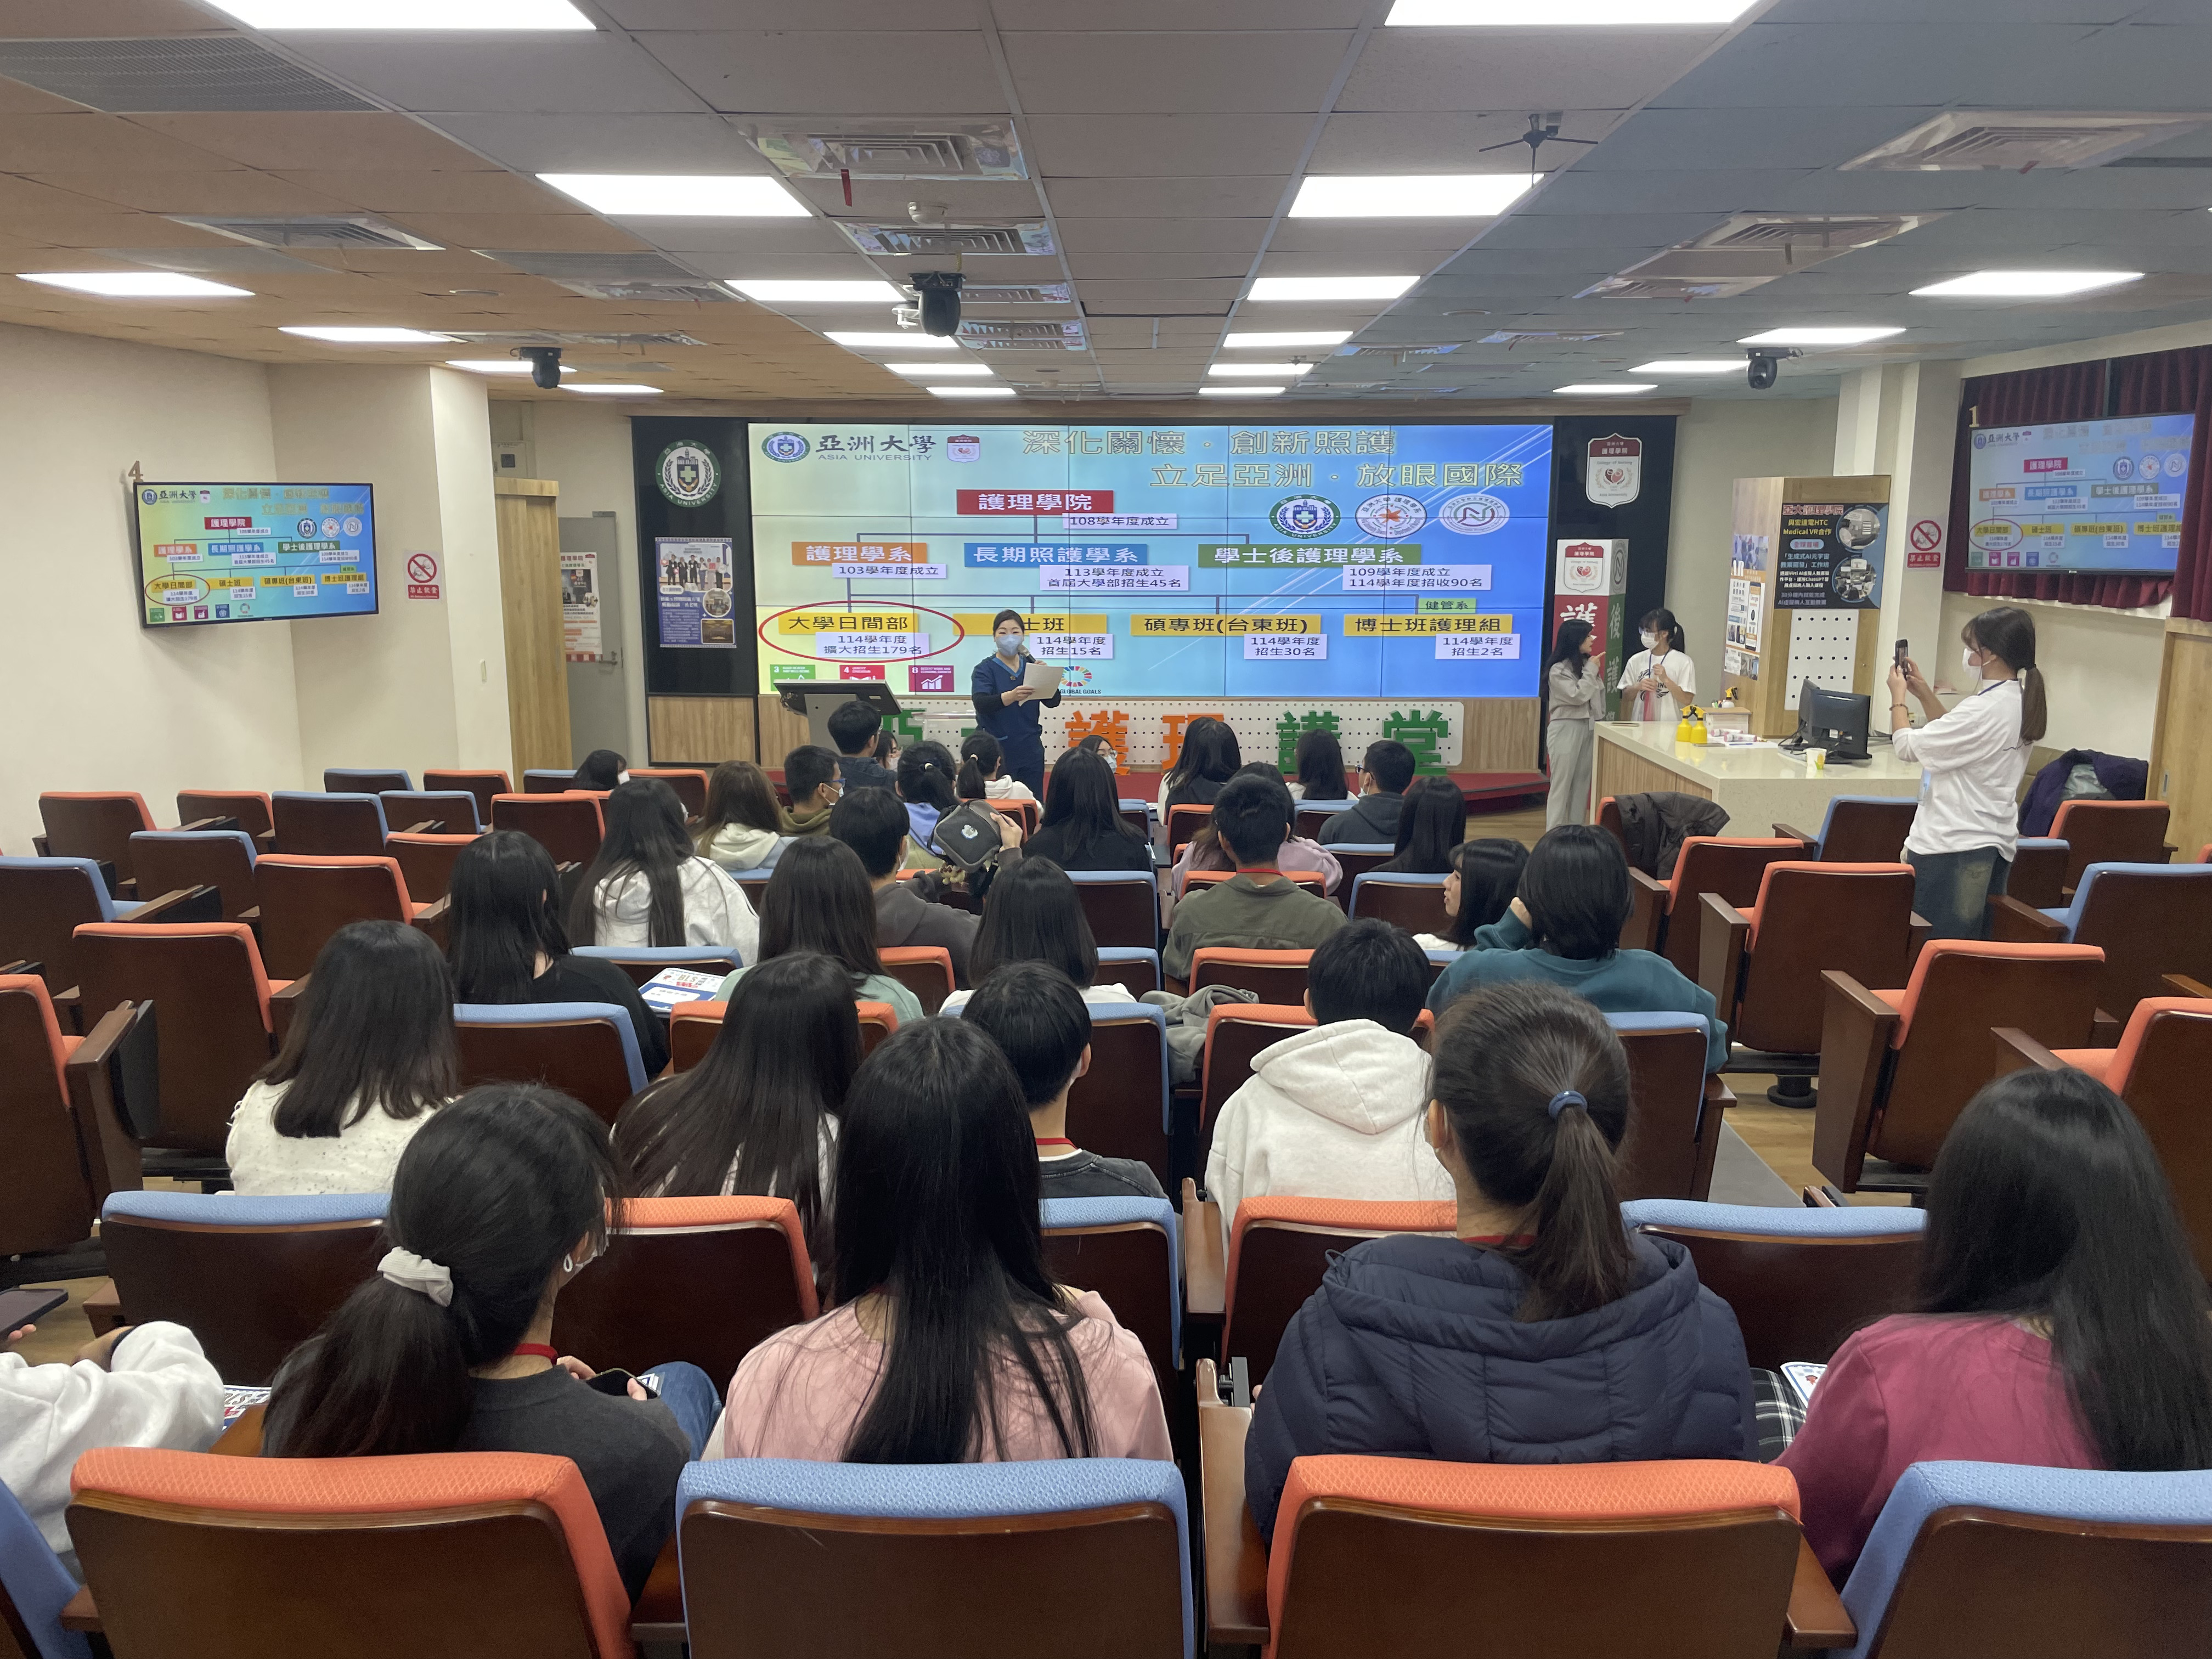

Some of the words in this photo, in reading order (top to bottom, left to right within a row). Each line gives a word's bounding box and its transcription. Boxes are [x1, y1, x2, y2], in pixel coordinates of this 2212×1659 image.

[1988, 432, 2019, 443] 亞洲大學
[815, 435, 936, 454] 亞洲大學
[128, 460, 144, 482] 4
[159, 490, 196, 500] 亞洲大學
[678, 483, 717, 505] UNIVERSITY
[978, 493, 1092, 512] 護理學院
[1070, 516, 1170, 527] 108學年度成立
[806, 546, 912, 562] 護理學系
[974, 547, 1139, 563] 長期照護學系
[1214, 548, 1404, 563] 學士後護理學系
[839, 566, 939, 575] 103學年度成立
[1064, 568, 1164, 577] 113學年度成立
[1349, 567, 1451, 577] 109學年度成立
[1047, 578, 1181, 588] 首屆大學部招生45名
[1349, 578, 1483, 588] 114學年度招收90名
[1425, 601, 1469, 610] 健管系
[788, 616, 909, 630] 大學日間部
[1024, 617, 1065, 631] 士班
[1144, 618, 1308, 634] 碩專班(台東班)
[1355, 618, 1502, 632] 博士班護理組
[838, 635, 907, 644] 114學年度
[1036, 636, 1106, 645] 114學年度
[1250, 636, 1321, 646] 114學年度
[1443, 636, 1513, 646] 114學年度
[823, 645, 922, 656] 擴大招生179名
[1041, 646, 1101, 656] 招生15名
[1255, 647, 1315, 657] 招生30名
[1451, 647, 1503, 656] 招生2名
[677, 974, 698, 983] BLS
